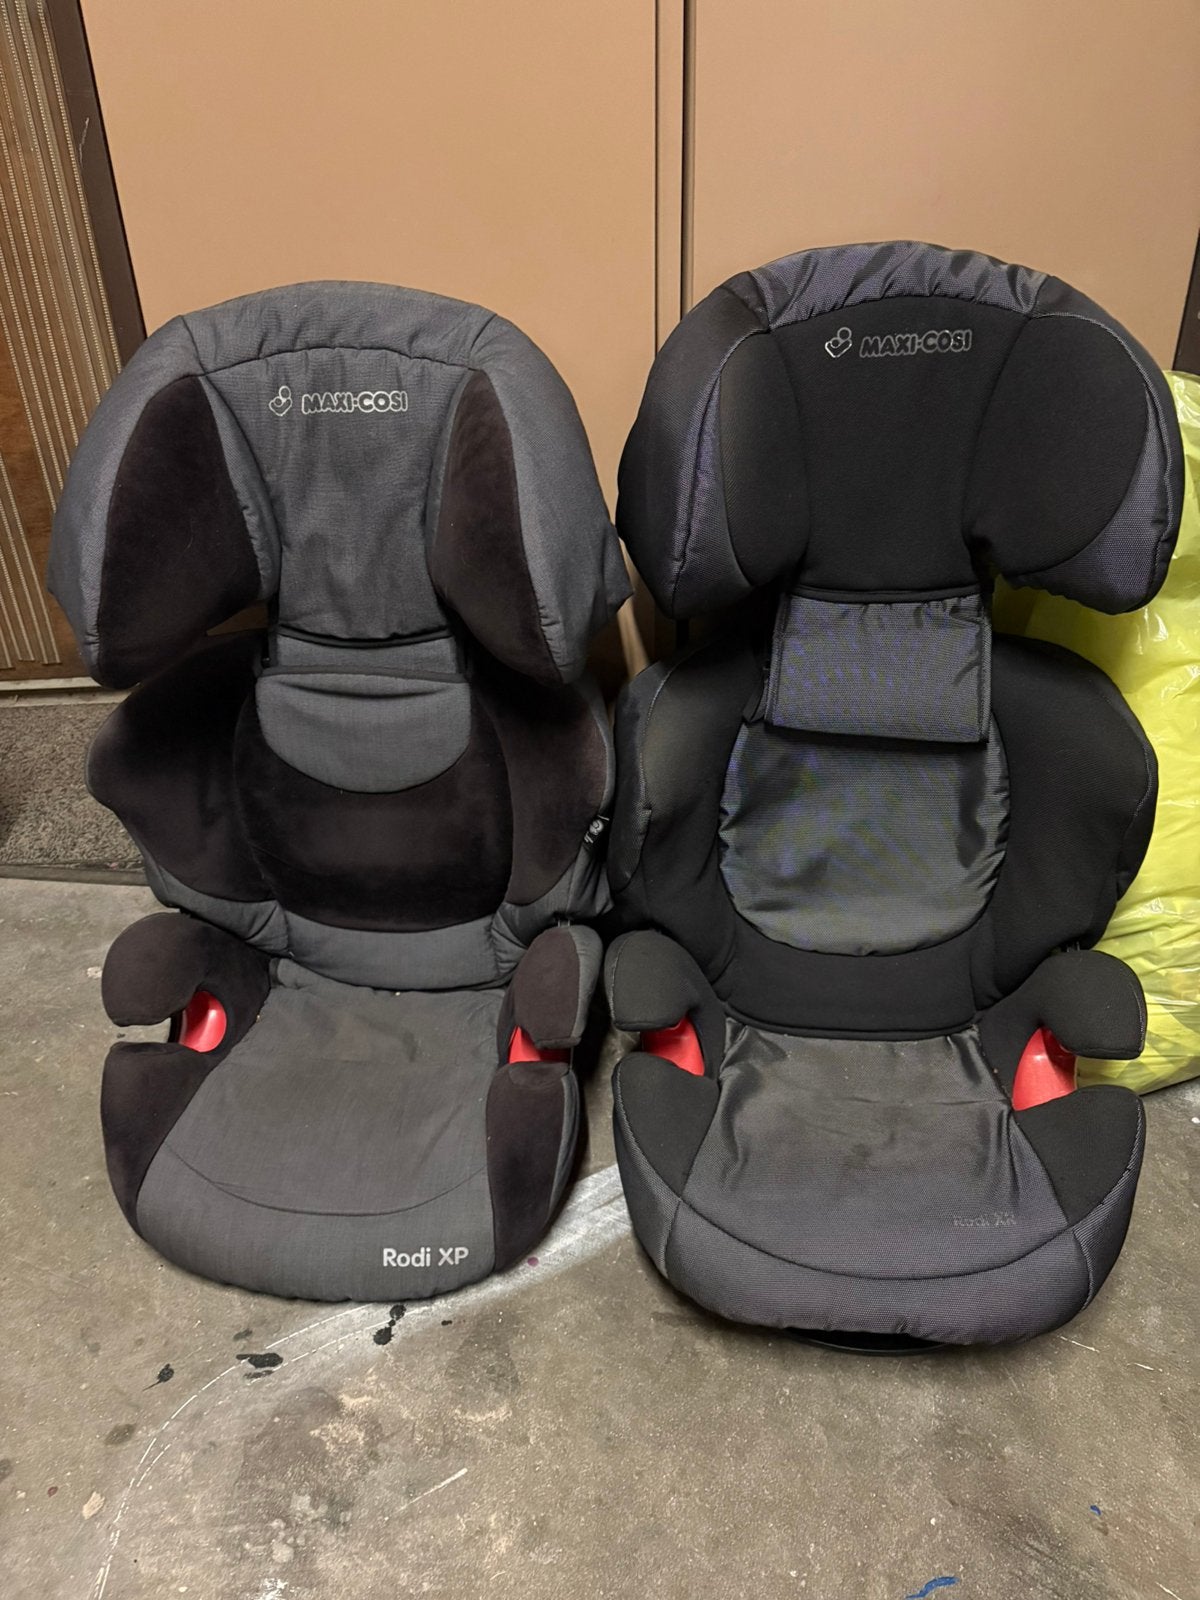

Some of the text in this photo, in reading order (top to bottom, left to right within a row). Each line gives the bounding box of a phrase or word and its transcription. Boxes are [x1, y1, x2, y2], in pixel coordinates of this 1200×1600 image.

[859, 329, 972, 358] MAXI-COSI
[301, 391, 408, 415] MAXI-COSI
[382, 1246, 469, 1267] Rodi XP
